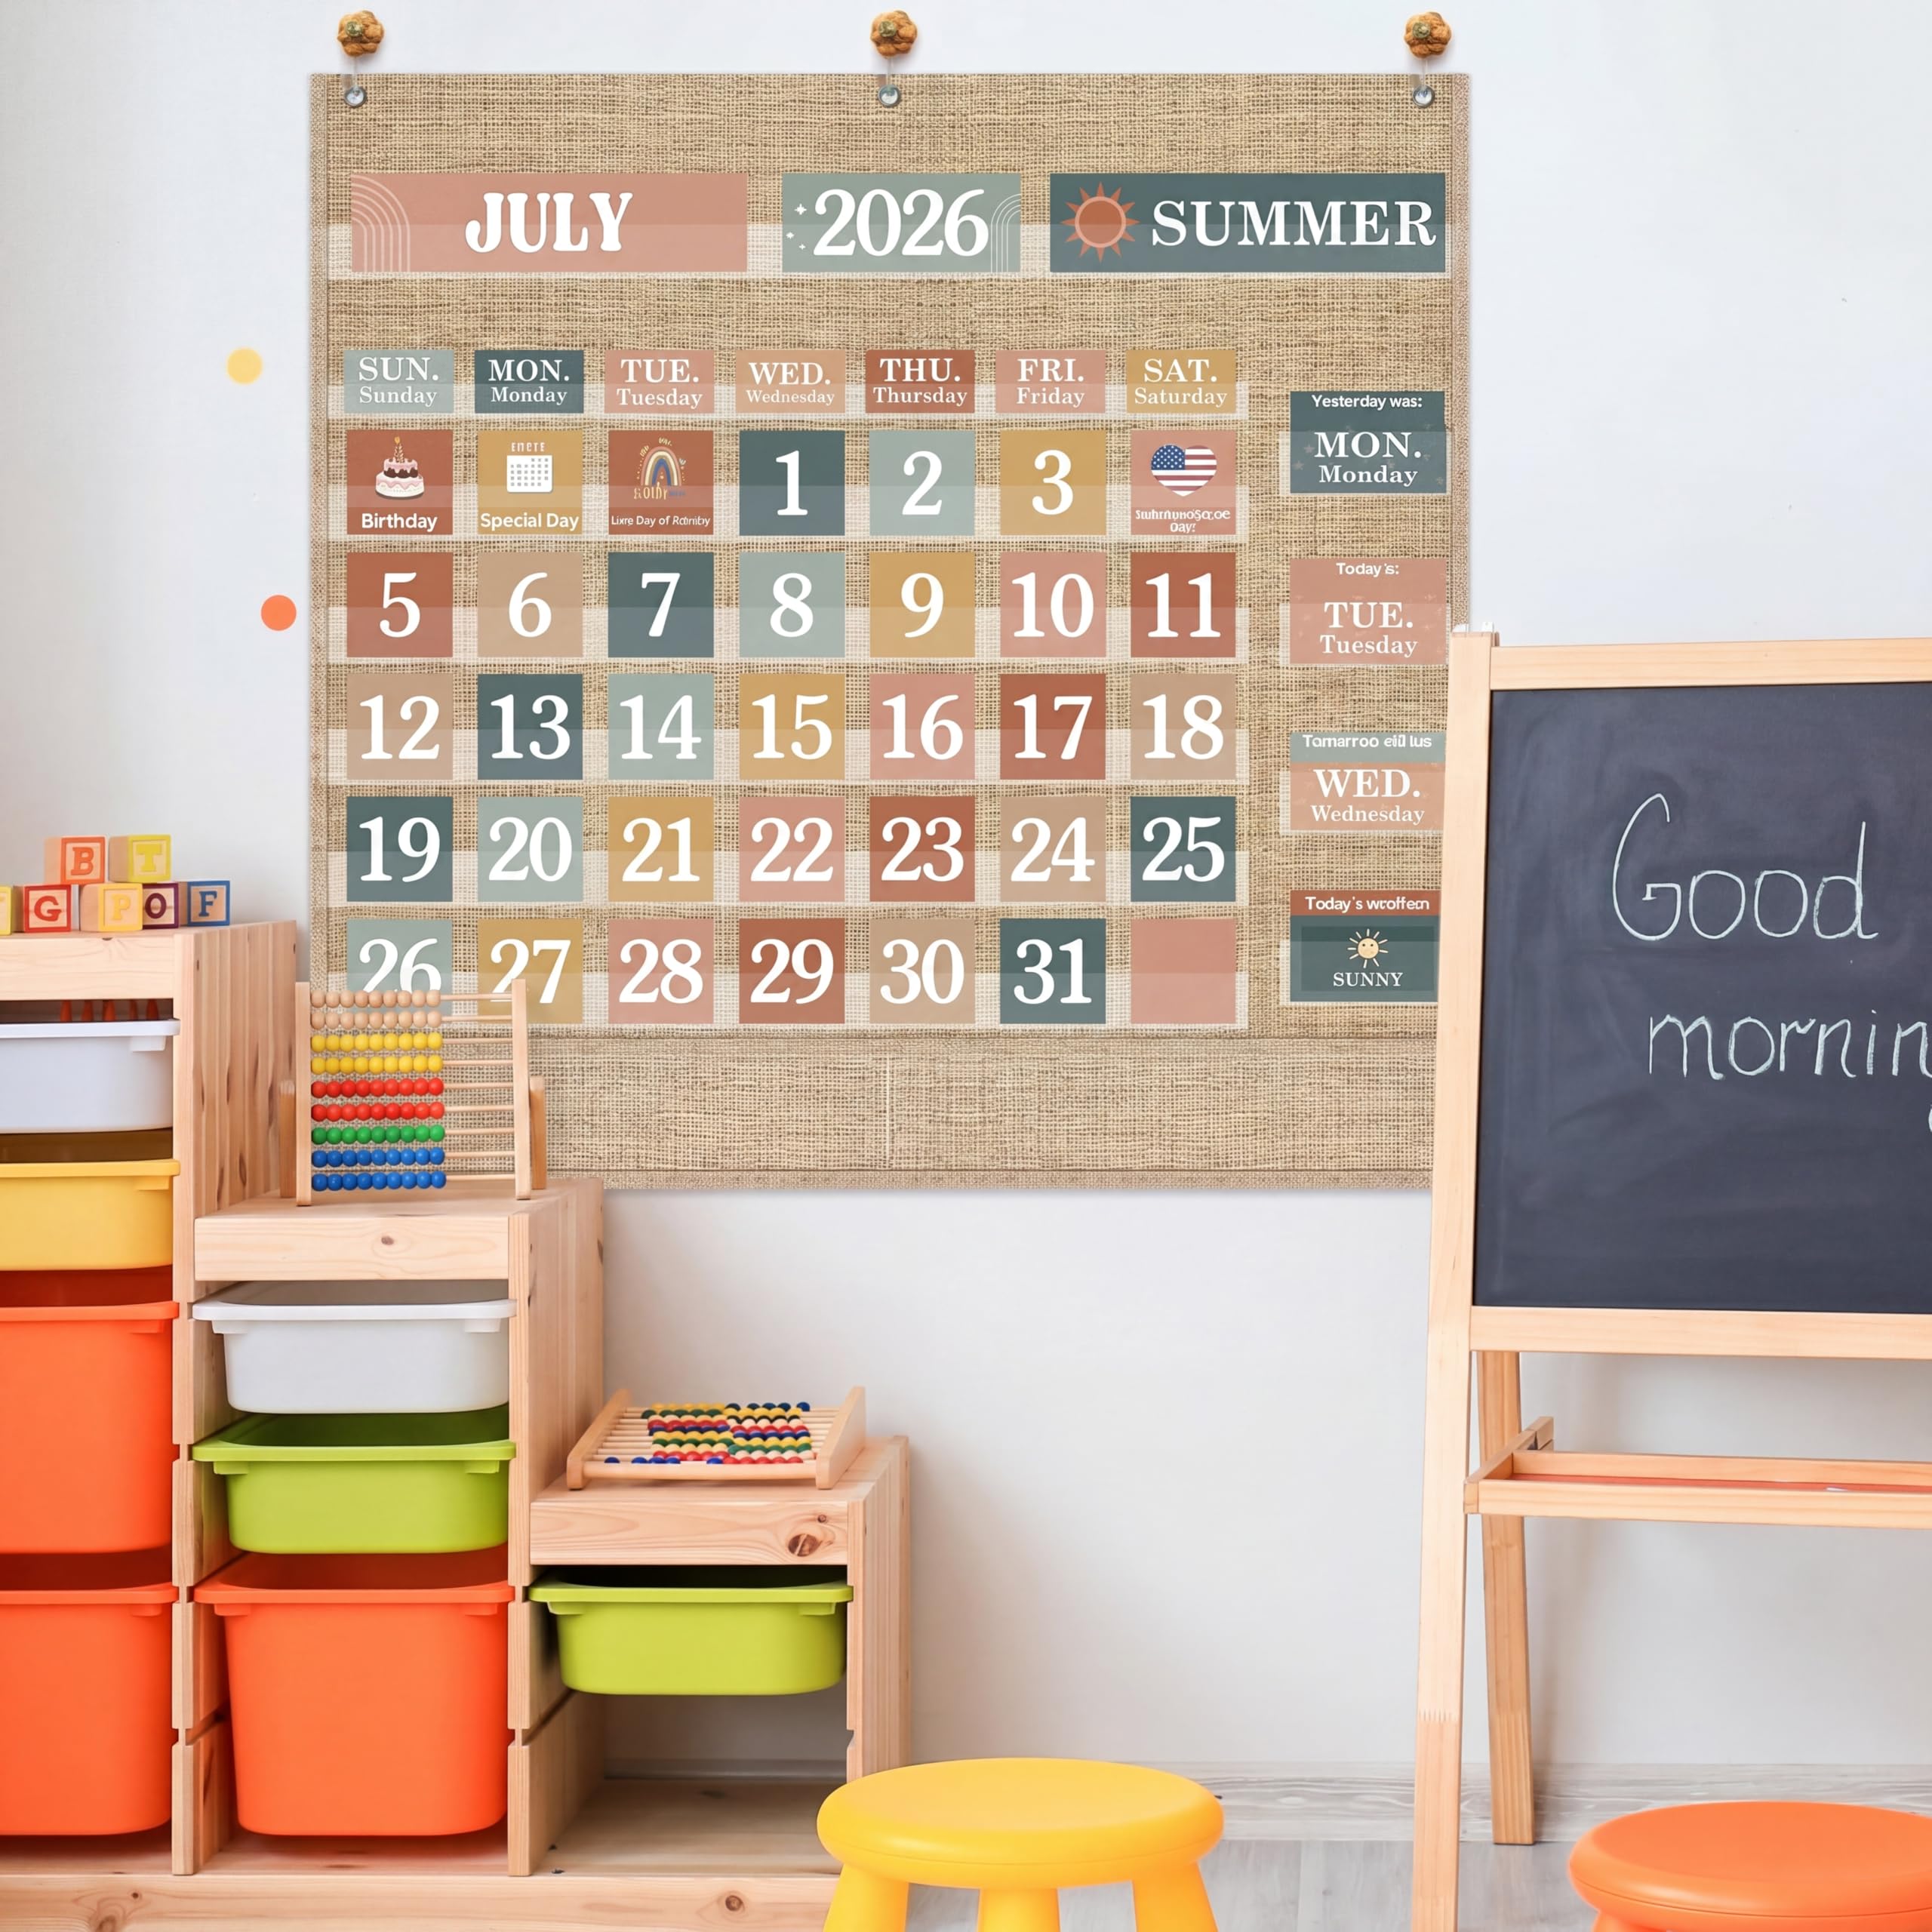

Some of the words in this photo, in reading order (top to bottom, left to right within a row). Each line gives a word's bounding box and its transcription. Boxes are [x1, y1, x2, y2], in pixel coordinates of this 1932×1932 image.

[466, 193, 632, 253] JULY
[814, 189, 988, 256] 2026
[1152, 201, 1436, 246] SUMMER
[359, 357, 438, 380] SUN.
[360, 386, 437, 407] Sunday
[489, 359, 569, 381] MON.
[491, 386, 567, 405] Monday
[621, 359, 698, 383] TUE.
[749, 362, 830, 385] WED.
[873, 387, 967, 406] Thursday
[880, 358, 960, 381] THU.
[1018, 359, 1084, 381] FRI.
[1145, 359, 1217, 382] SAT.
[617, 388, 703, 409] Tuesday
[746, 389, 834, 406] Wednesday
[1017, 387, 1084, 408] Friday
[1135, 387, 1227, 408] Saturday
[1312, 395, 1386, 411] Yesterday
[1389, 398, 1422, 407] was:
[1315, 432, 1421, 457] MON.
[777, 451, 808, 515] 1
[903, 451, 942, 515] 2
[1032, 450, 1073, 515] 3
[1319, 465, 1417, 487] Monday
[362, 513, 437, 532] Birthday
[481, 512, 542, 531] Special
[547, 513, 579, 531] Day
[636, 515, 656, 528] Day
[659, 515, 670, 525] of
[380, 573, 420, 637] 5
[509, 573, 551, 637] 6
[642, 573, 680, 636] 7
[771, 573, 813, 637] 8
[902, 573, 943, 638] 9
[1012, 573, 1094, 637] 10
[1146, 574, 1220, 637] 11
[1324, 602, 1413, 628] TUE.
[1320, 635, 1417, 657] Tuesday
[361, 695, 439, 759] 12
[491, 694, 570, 759] 13
[620, 695, 701, 759] 14
[752, 694, 832, 759] 15
[883, 694, 963, 760] 16
[1014, 694, 1092, 759] 17
[1143, 694, 1223, 759] 18
[1314, 770, 1420, 797] WED.
[1311, 805, 1424, 825] Wednesday
[71, 847, 94, 875] B
[137, 844, 163, 872] T
[360, 817, 439, 882] 19
[489, 817, 571, 881] 20
[623, 817, 700, 881] 21
[751, 818, 833, 881] 22
[881, 817, 963, 881] 23
[1011, 817, 1095, 881] 24
[1143, 817, 1224, 881] 25
[1613, 794, 1878, 940] Good
[34, 895, 62, 921] G
[111, 894, 131, 920] P
[145, 893, 167, 919] O
[198, 891, 217, 917] F
[360, 939, 441, 993] 26
[490, 938, 571, 1004] 27
[620, 939, 703, 1003] 28
[751, 939, 833, 1004] 29
[881, 940, 964, 1004] 30
[1014, 939, 1091, 1004] 31
[1334, 972, 1403, 986] SUNNY
[1650, 1010, 1932, 1132] mornin
